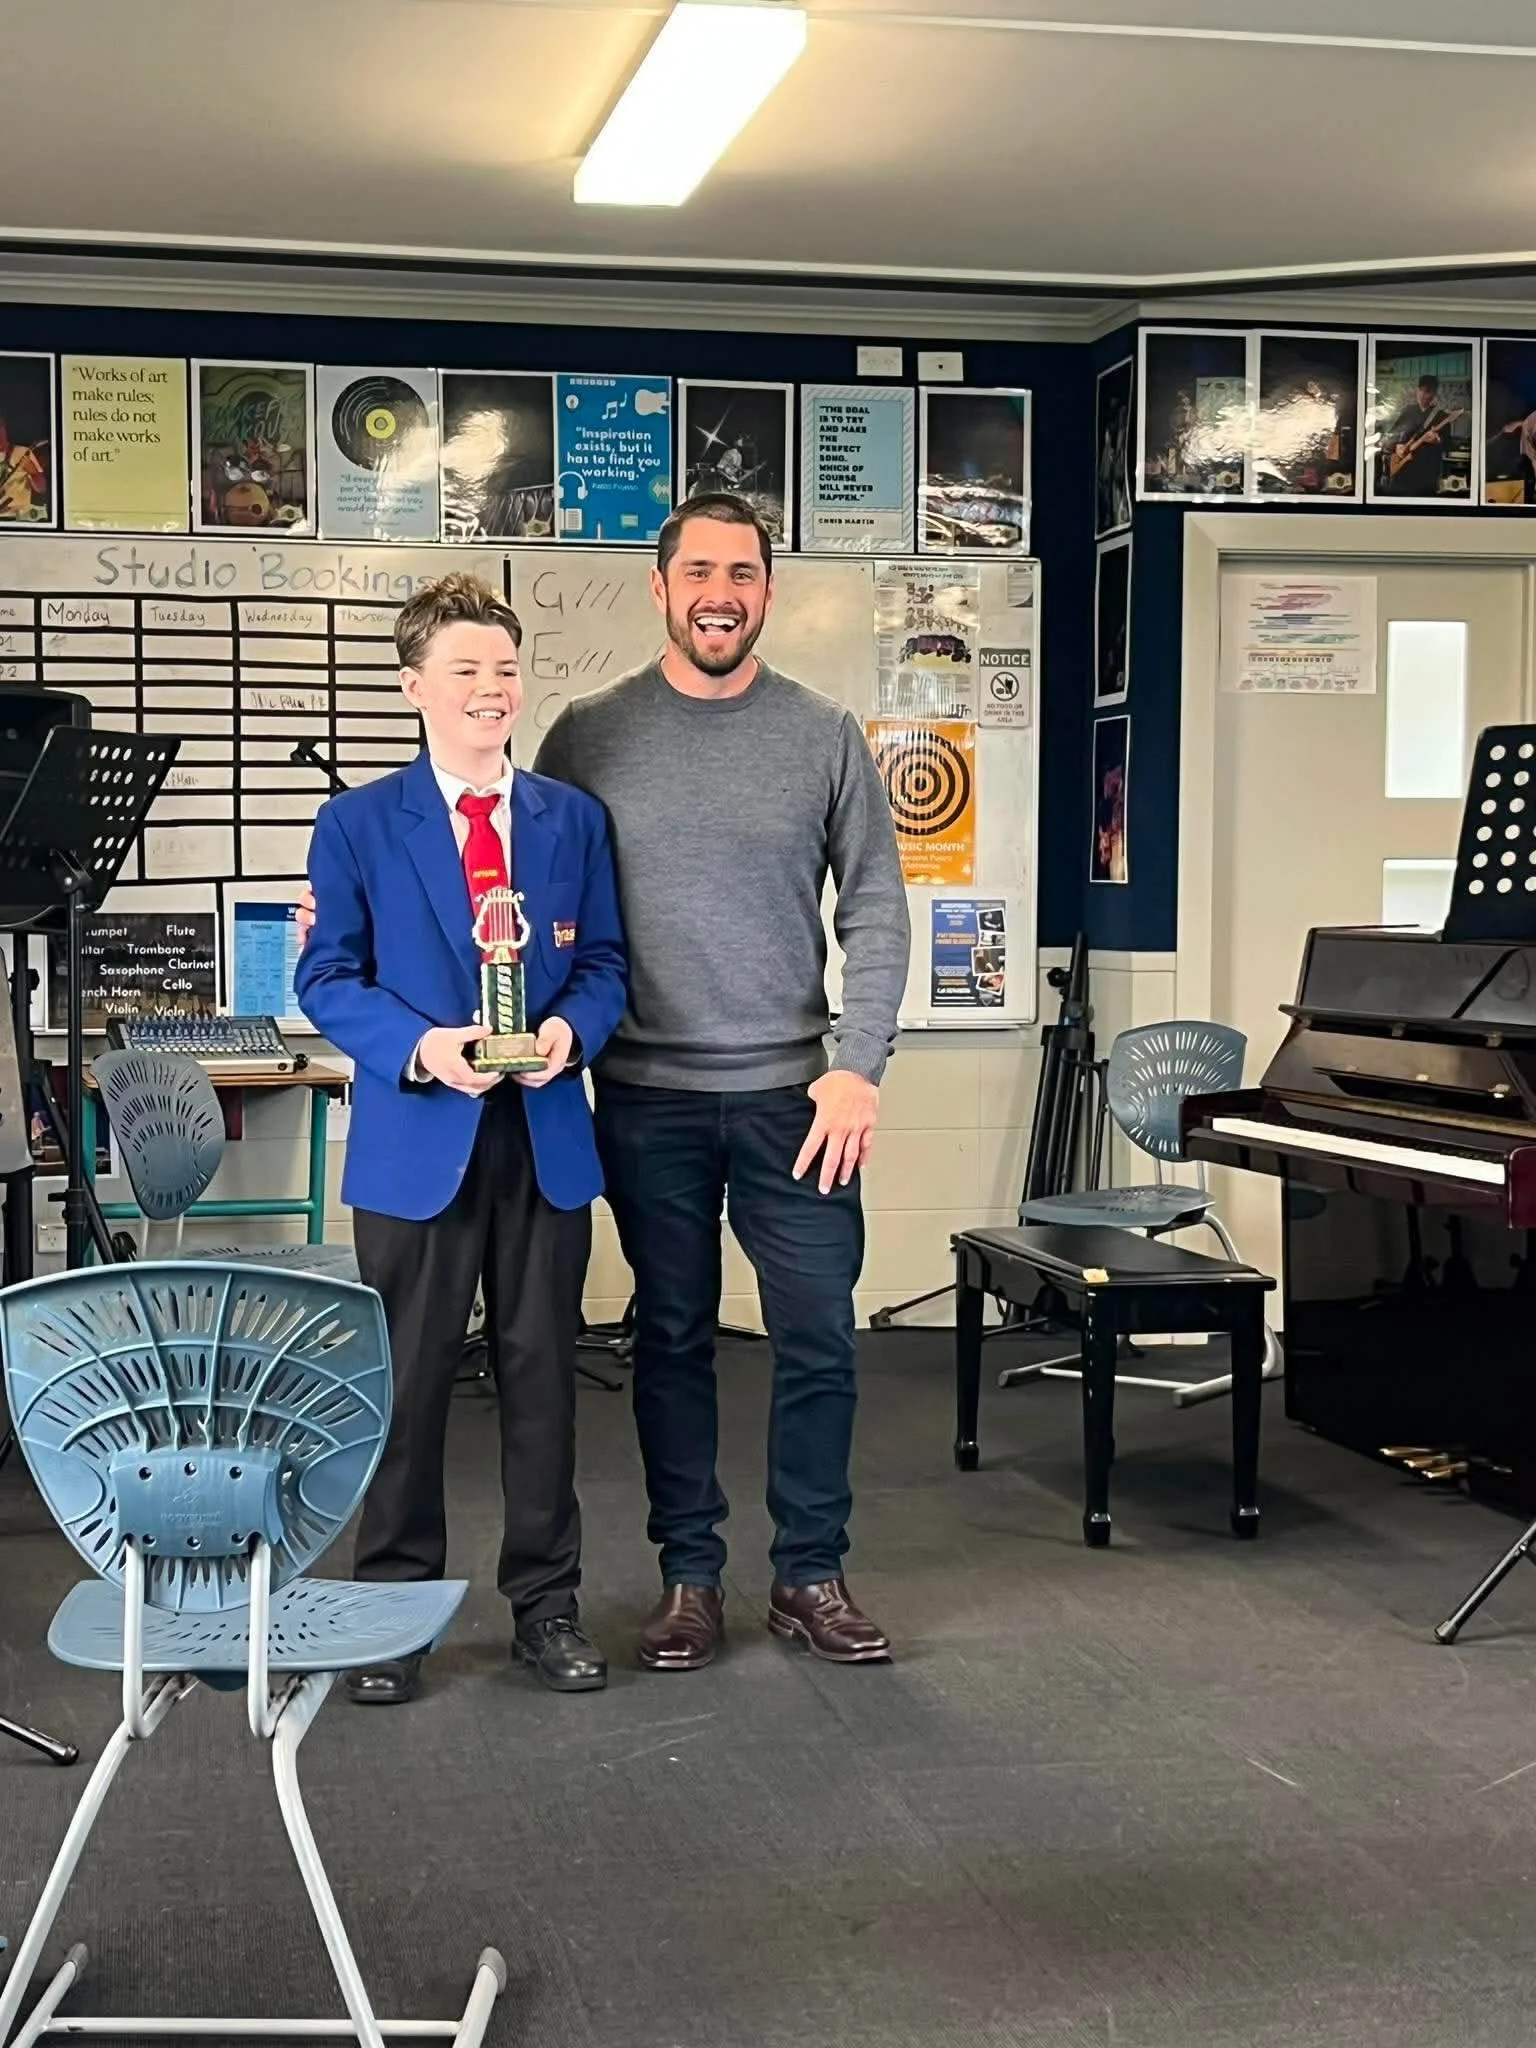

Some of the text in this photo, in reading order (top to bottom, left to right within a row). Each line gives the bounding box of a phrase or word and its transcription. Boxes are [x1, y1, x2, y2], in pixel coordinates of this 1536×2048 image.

[130, 367, 144, 383] of
[148, 372, 168, 383] art
[72, 388, 113, 401] make
[73, 408, 157, 423] rules do not
[73, 428, 161, 443] make works
[575, 440, 653, 453] exists, but it
[73, 447, 88, 462] of
[567, 452, 661, 472] has to find you
[93, 546, 237, 590] Studio
[47, 601, 110, 625] Monday
[150, 606, 207, 626] Tuesday
[245, 609, 313, 628] Wednesday
[980, 653, 1030, 665] NOTICE
[900, 842, 965, 852] USIC MONTH
[86, 927, 128, 939] umpet
[166, 924, 196, 937] Flute
[82, 945, 105, 955] itar
[127, 943, 186, 955] Trombone
[100, 963, 165, 977] Saxophone
[168, 958, 217, 970] Clarinet
[162, 978, 193, 990] Cello
[81, 986, 141, 998] ench Horn
[105, 1002, 139, 1014] Violin
